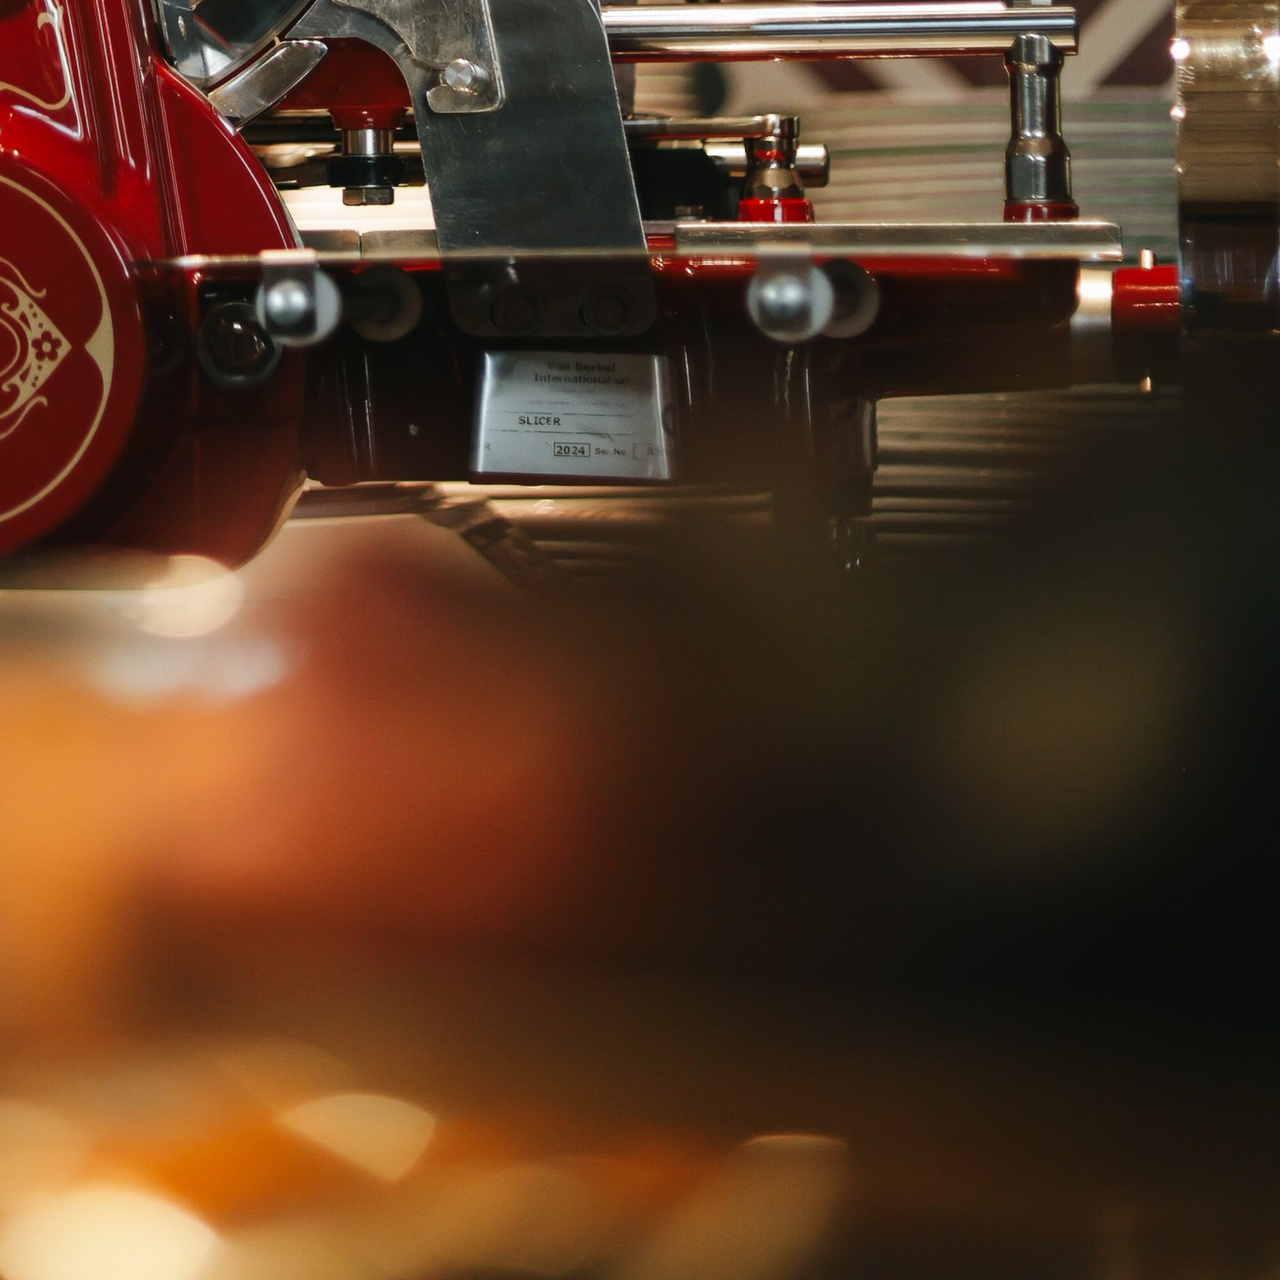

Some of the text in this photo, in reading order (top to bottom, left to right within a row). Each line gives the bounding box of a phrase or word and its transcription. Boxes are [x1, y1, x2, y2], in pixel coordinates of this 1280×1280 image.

[534, 373, 612, 385] International
[517, 415, 562, 427] SLICER
[556, 445, 587, 456] 2024
